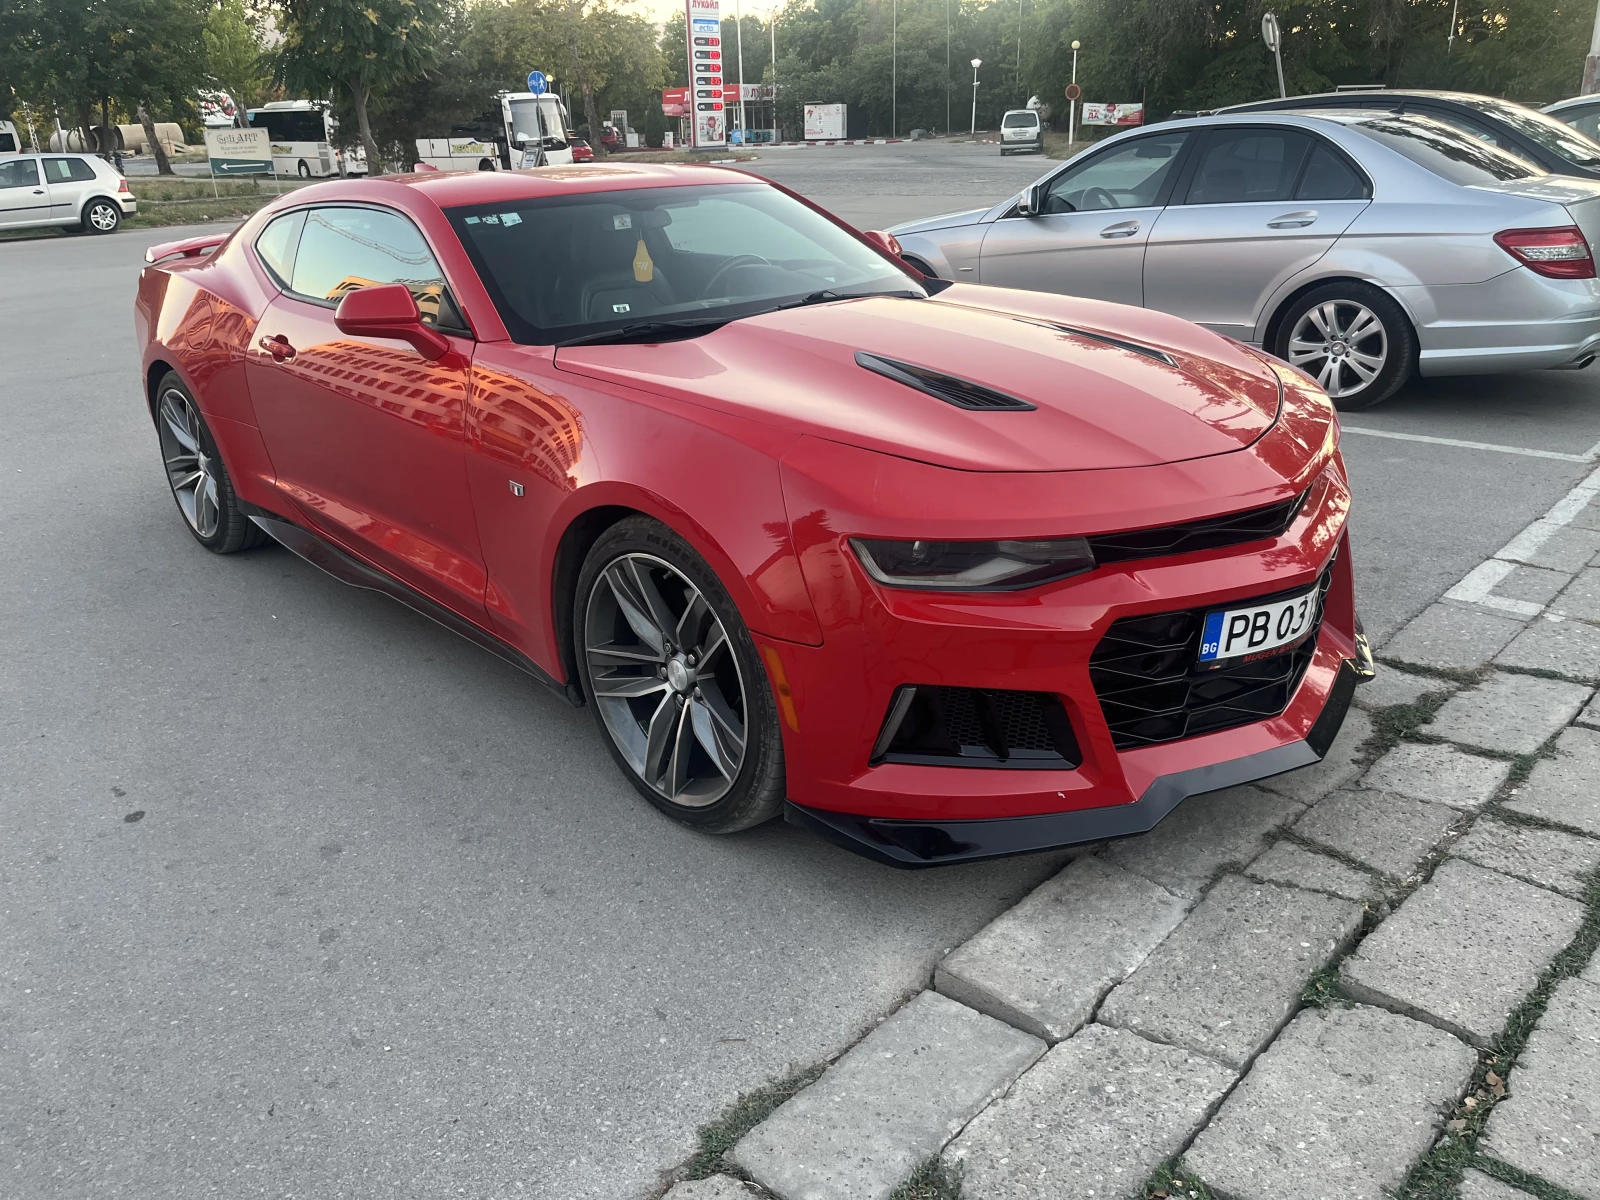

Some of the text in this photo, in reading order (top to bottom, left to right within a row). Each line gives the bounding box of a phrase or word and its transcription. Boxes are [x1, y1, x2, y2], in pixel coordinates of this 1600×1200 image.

[235, 132, 258, 144] ART
[1224, 594, 1316, 653] PB 03
[1201, 642, 1218, 655] BG
[1242, 648, 1278, 663] MUGEN
